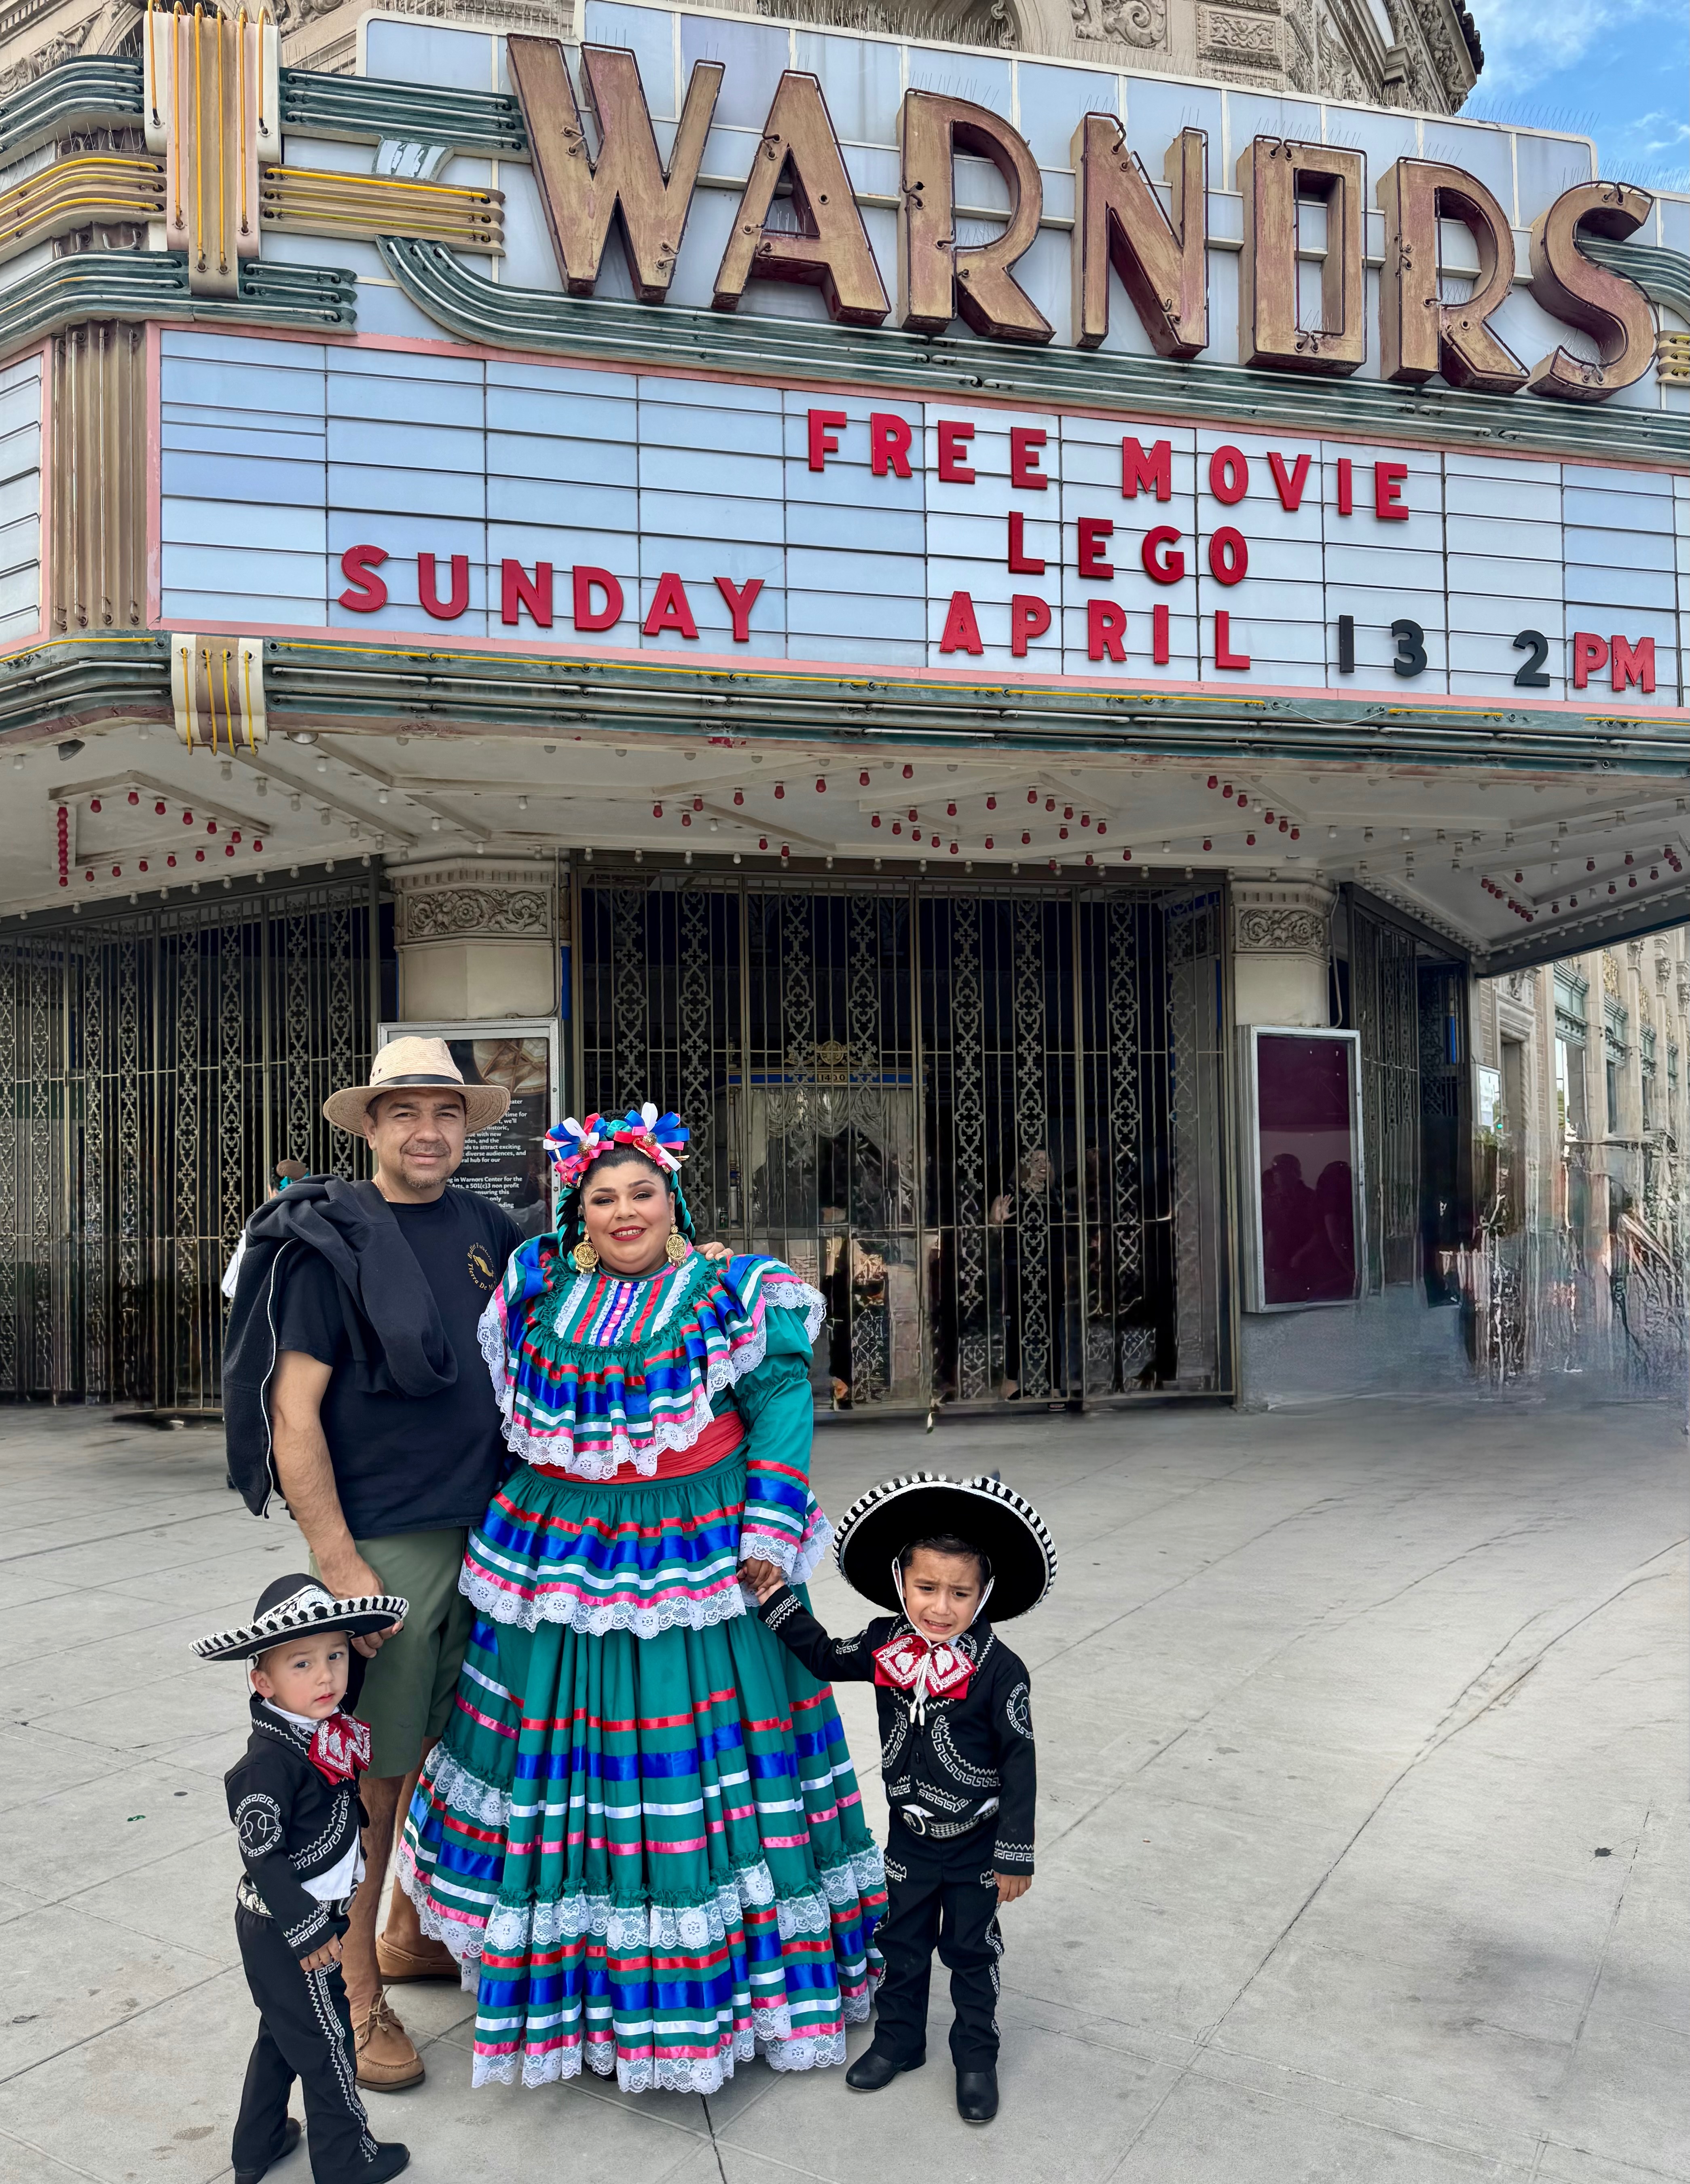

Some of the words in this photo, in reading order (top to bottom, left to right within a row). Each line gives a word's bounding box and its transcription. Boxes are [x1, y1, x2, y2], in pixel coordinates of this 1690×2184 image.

[506, 34, 1658, 400] WARNORS
[807, 408, 1048, 490] FREE
[1121, 436, 1409, 521] MOVIE
[1007, 511, 1249, 586] LEGO
[337, 544, 765, 643] SUNDAY
[939, 590, 1251, 671] APRIL
[1338, 614, 1428, 678] 13
[468, 1263, 479, 1284] Tierra
